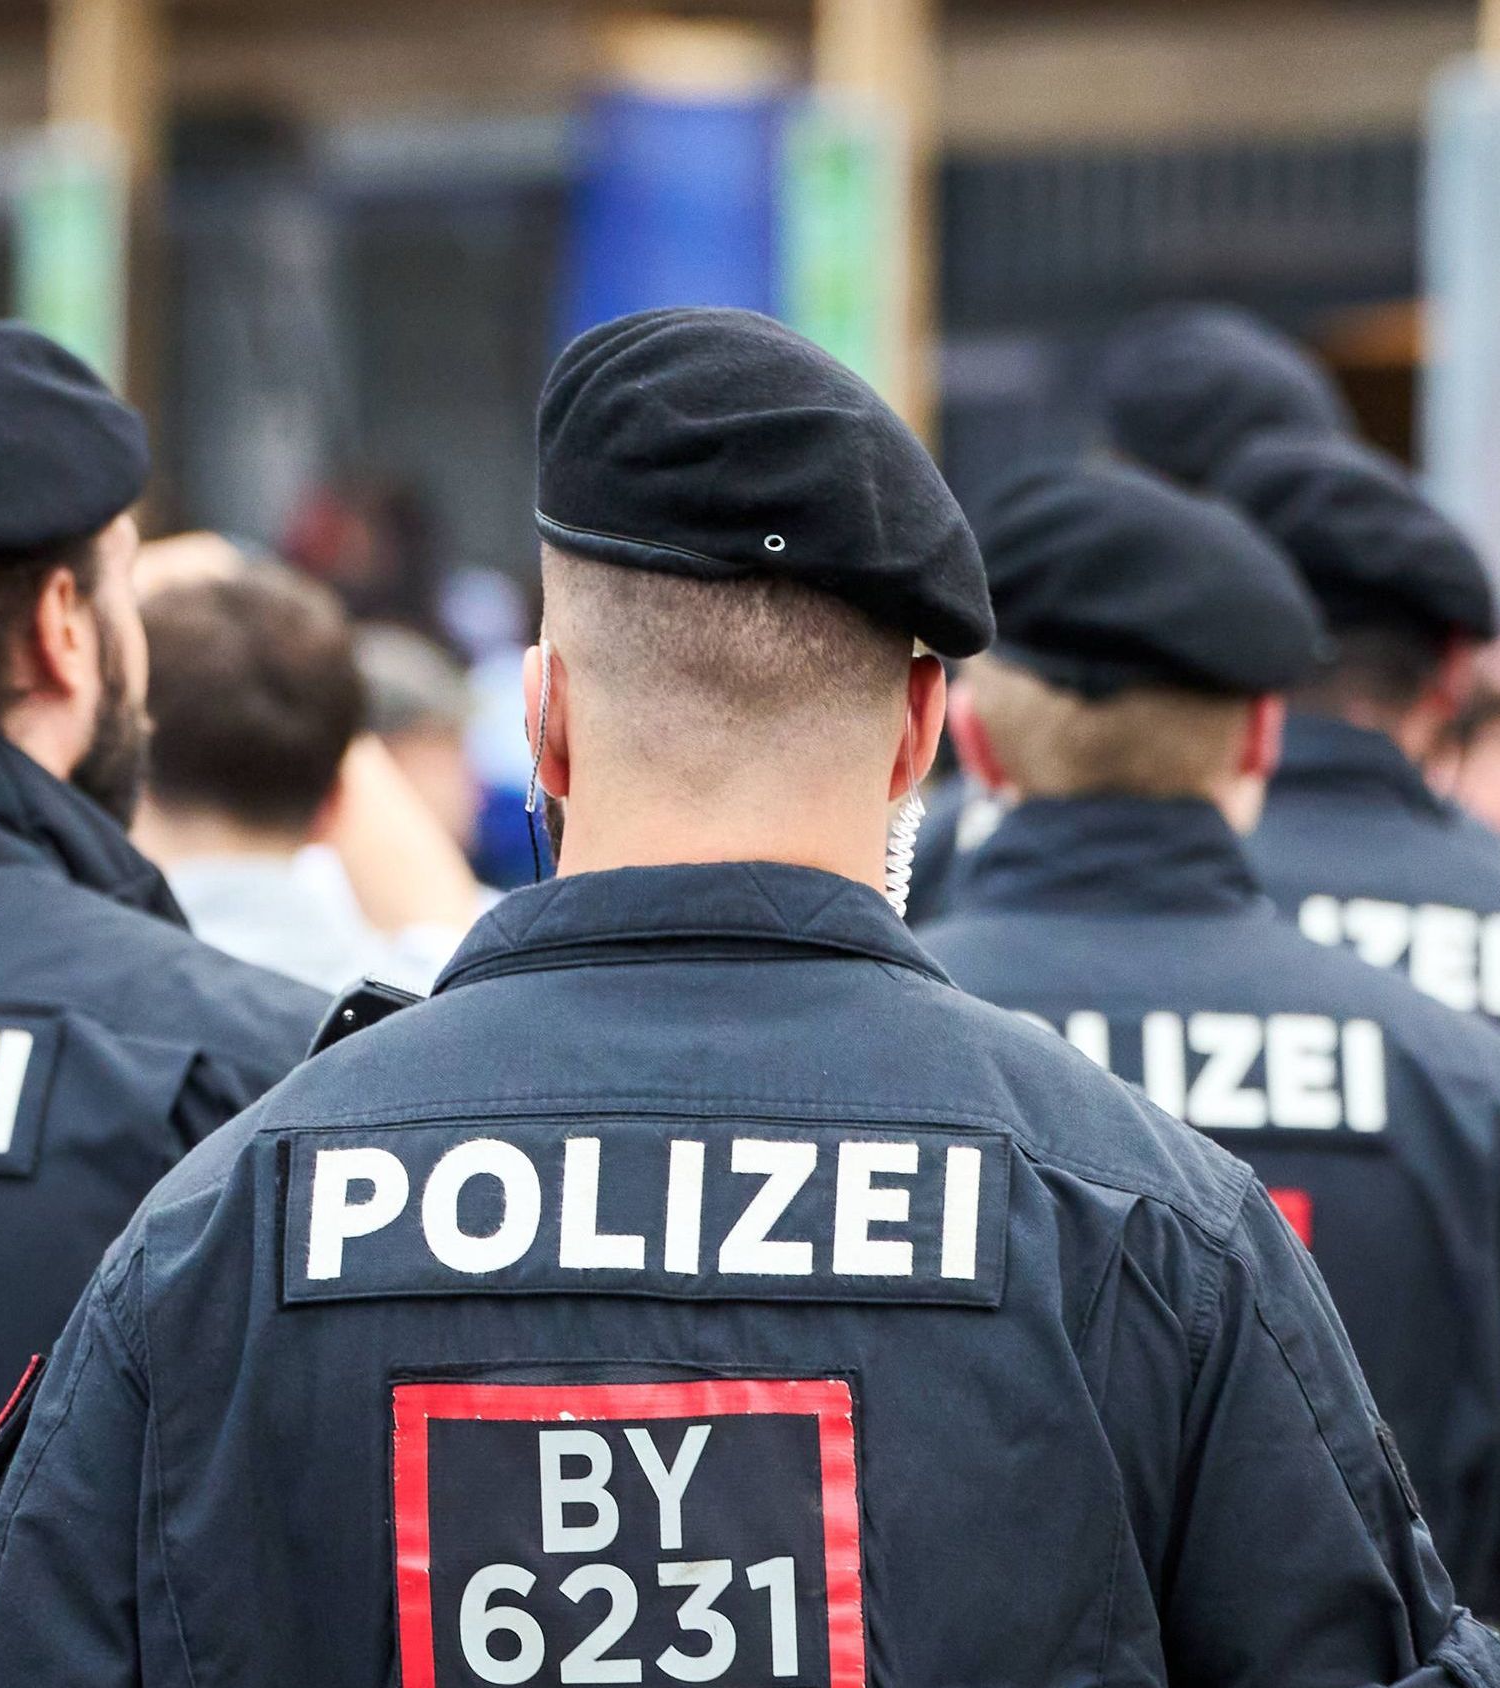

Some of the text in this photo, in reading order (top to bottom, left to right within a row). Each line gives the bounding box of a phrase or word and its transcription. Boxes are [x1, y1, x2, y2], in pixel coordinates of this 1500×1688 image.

[306, 1136, 982, 1281] POLIZEI
[538, 1424, 712, 1554] BY
[459, 1556, 799, 1685] 6231
